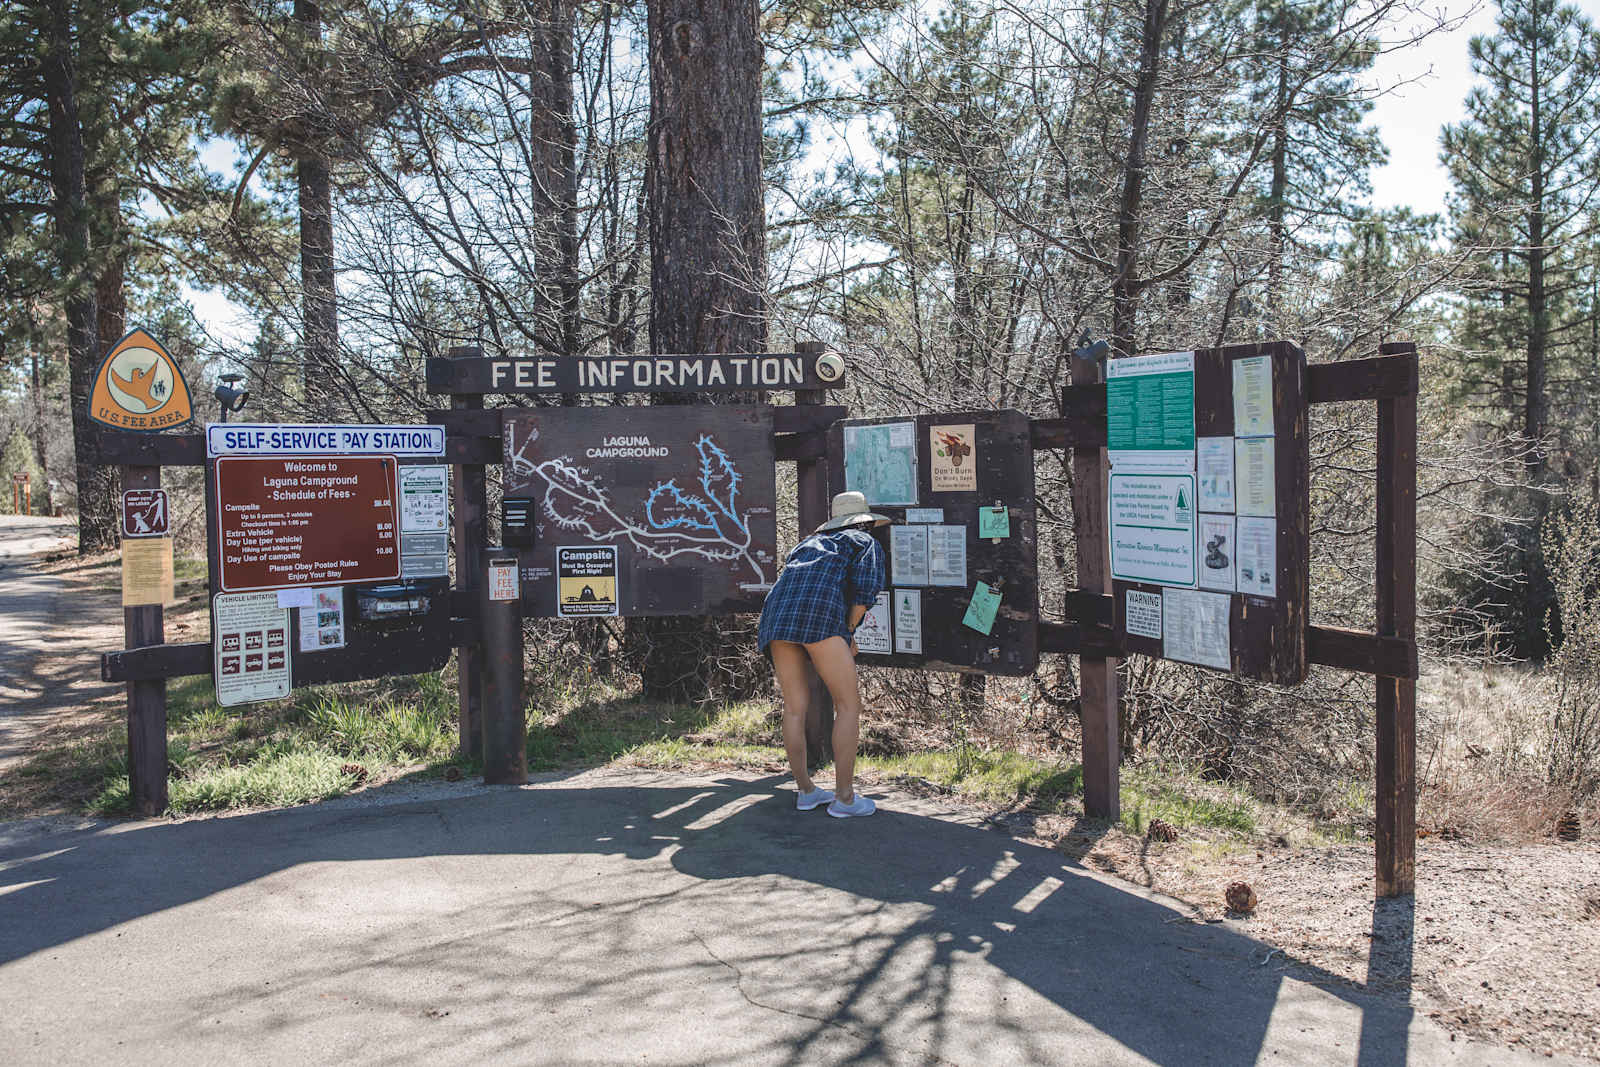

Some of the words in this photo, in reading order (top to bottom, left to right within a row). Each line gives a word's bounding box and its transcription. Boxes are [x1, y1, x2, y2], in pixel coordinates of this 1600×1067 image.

[491, 360, 557, 388] FEE
[578, 357, 804, 387] INFORMATION
[99, 408, 119, 424] U.S.
[121, 415, 146, 426] FEE
[150, 410, 184, 427] AREA
[225, 431, 337, 449] SELF-SERVICE
[343, 432, 369, 449] PAY
[373, 432, 432, 449] STATION
[603, 435, 650, 447] LAGUNA
[586, 447, 669, 458] CAMPGROUND
[284, 462, 327, 472] Welcome
[328, 462, 338, 471] to
[934, 467, 953, 475] Don't
[955, 467, 972, 475] Burn
[263, 476, 298, 488] Laguna
[300, 474, 358, 488] Campground
[272, 489, 316, 500] Schedule
[317, 489, 327, 499] of
[328, 488, 350, 499] Fees
[225, 503, 260, 512] Campsite
[247, 528, 274, 537] Vehicle
[226, 538, 241, 547] Day
[243, 537, 258, 545] Use
[258, 537, 273, 546] (per
[275, 535, 303, 544] vehicle)
[227, 555, 242, 563] Day
[243, 554, 258, 562] Use
[259, 553, 267, 561] of
[268, 551, 301, 561] campsite
[561, 549, 612, 562] Campsite
[269, 564, 293, 573] Please
[294, 563, 313, 571] Obey
[314, 561, 338, 569] Posted
[339, 559, 359, 568] Rules
[288, 573, 308, 581] Enjoy
[309, 571, 326, 579] Your
[327, 570, 342, 578] Stay
[497, 568, 512, 577] PAY
[497, 578, 512, 588] FEE
[222, 595, 245, 603] VEHICLE
[494, 589, 516, 599] HERE
[1128, 592, 1161, 607] WARNING
